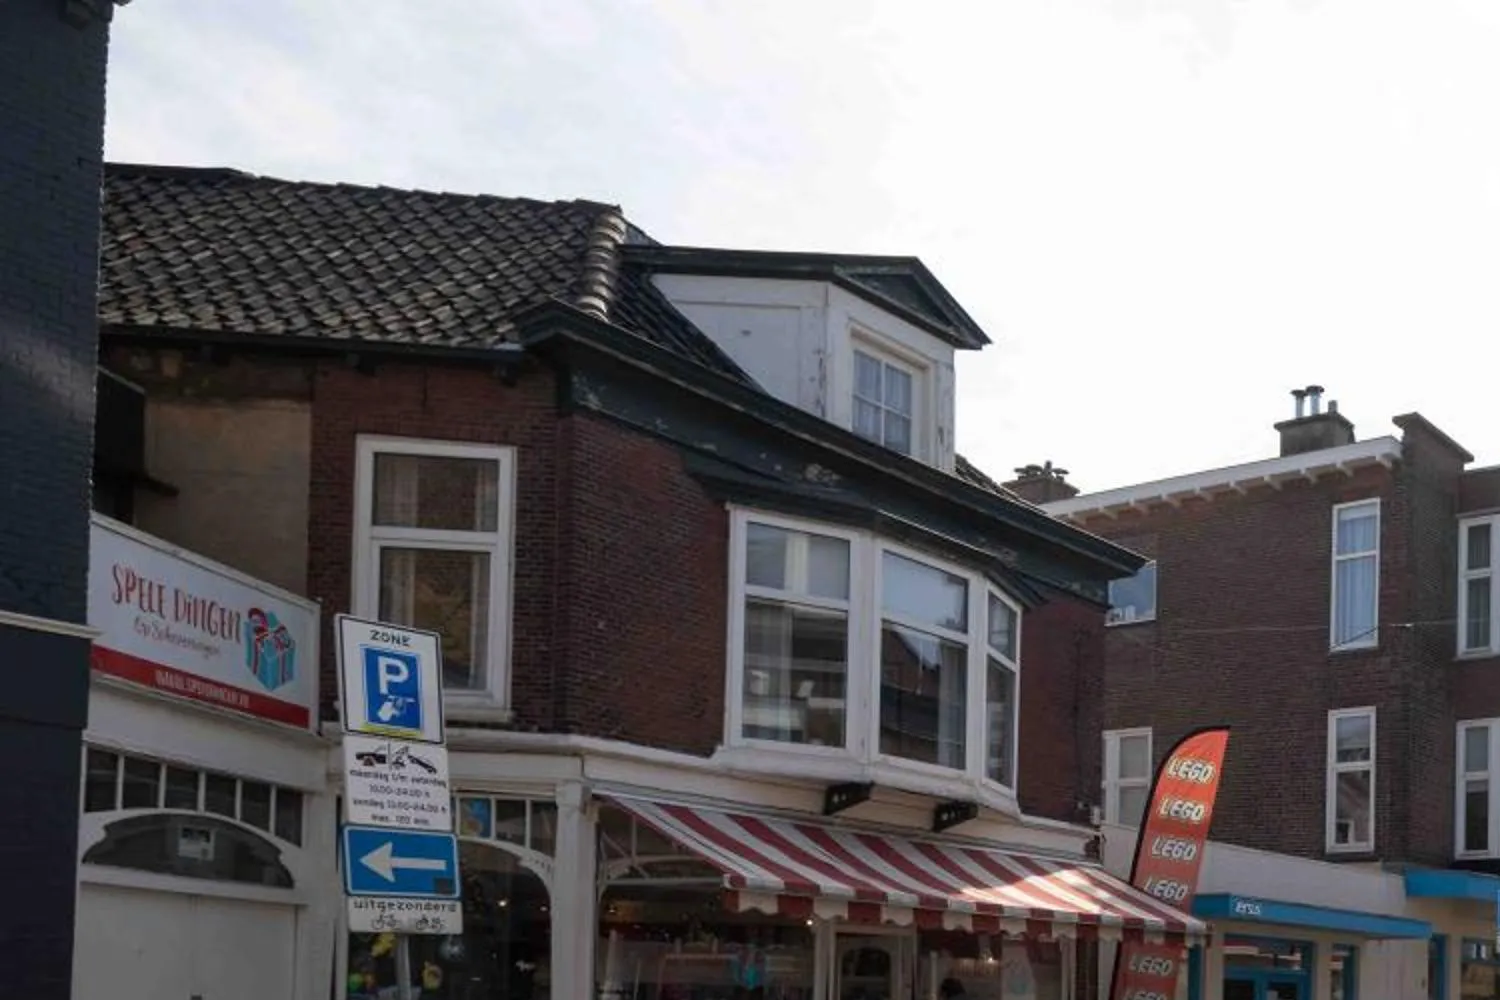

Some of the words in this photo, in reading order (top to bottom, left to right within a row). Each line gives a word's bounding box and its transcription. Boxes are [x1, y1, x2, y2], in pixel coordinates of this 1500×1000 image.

[369, 628, 412, 647] ZONE
[377, 656, 410, 696] P
[1166, 756, 1216, 784] LEGO
[1159, 796, 1205, 822] LEGO
[1151, 836, 1198, 862] LEGO
[1143, 875, 1189, 902] LEGO
[1129, 953, 1173, 976] LEGO
